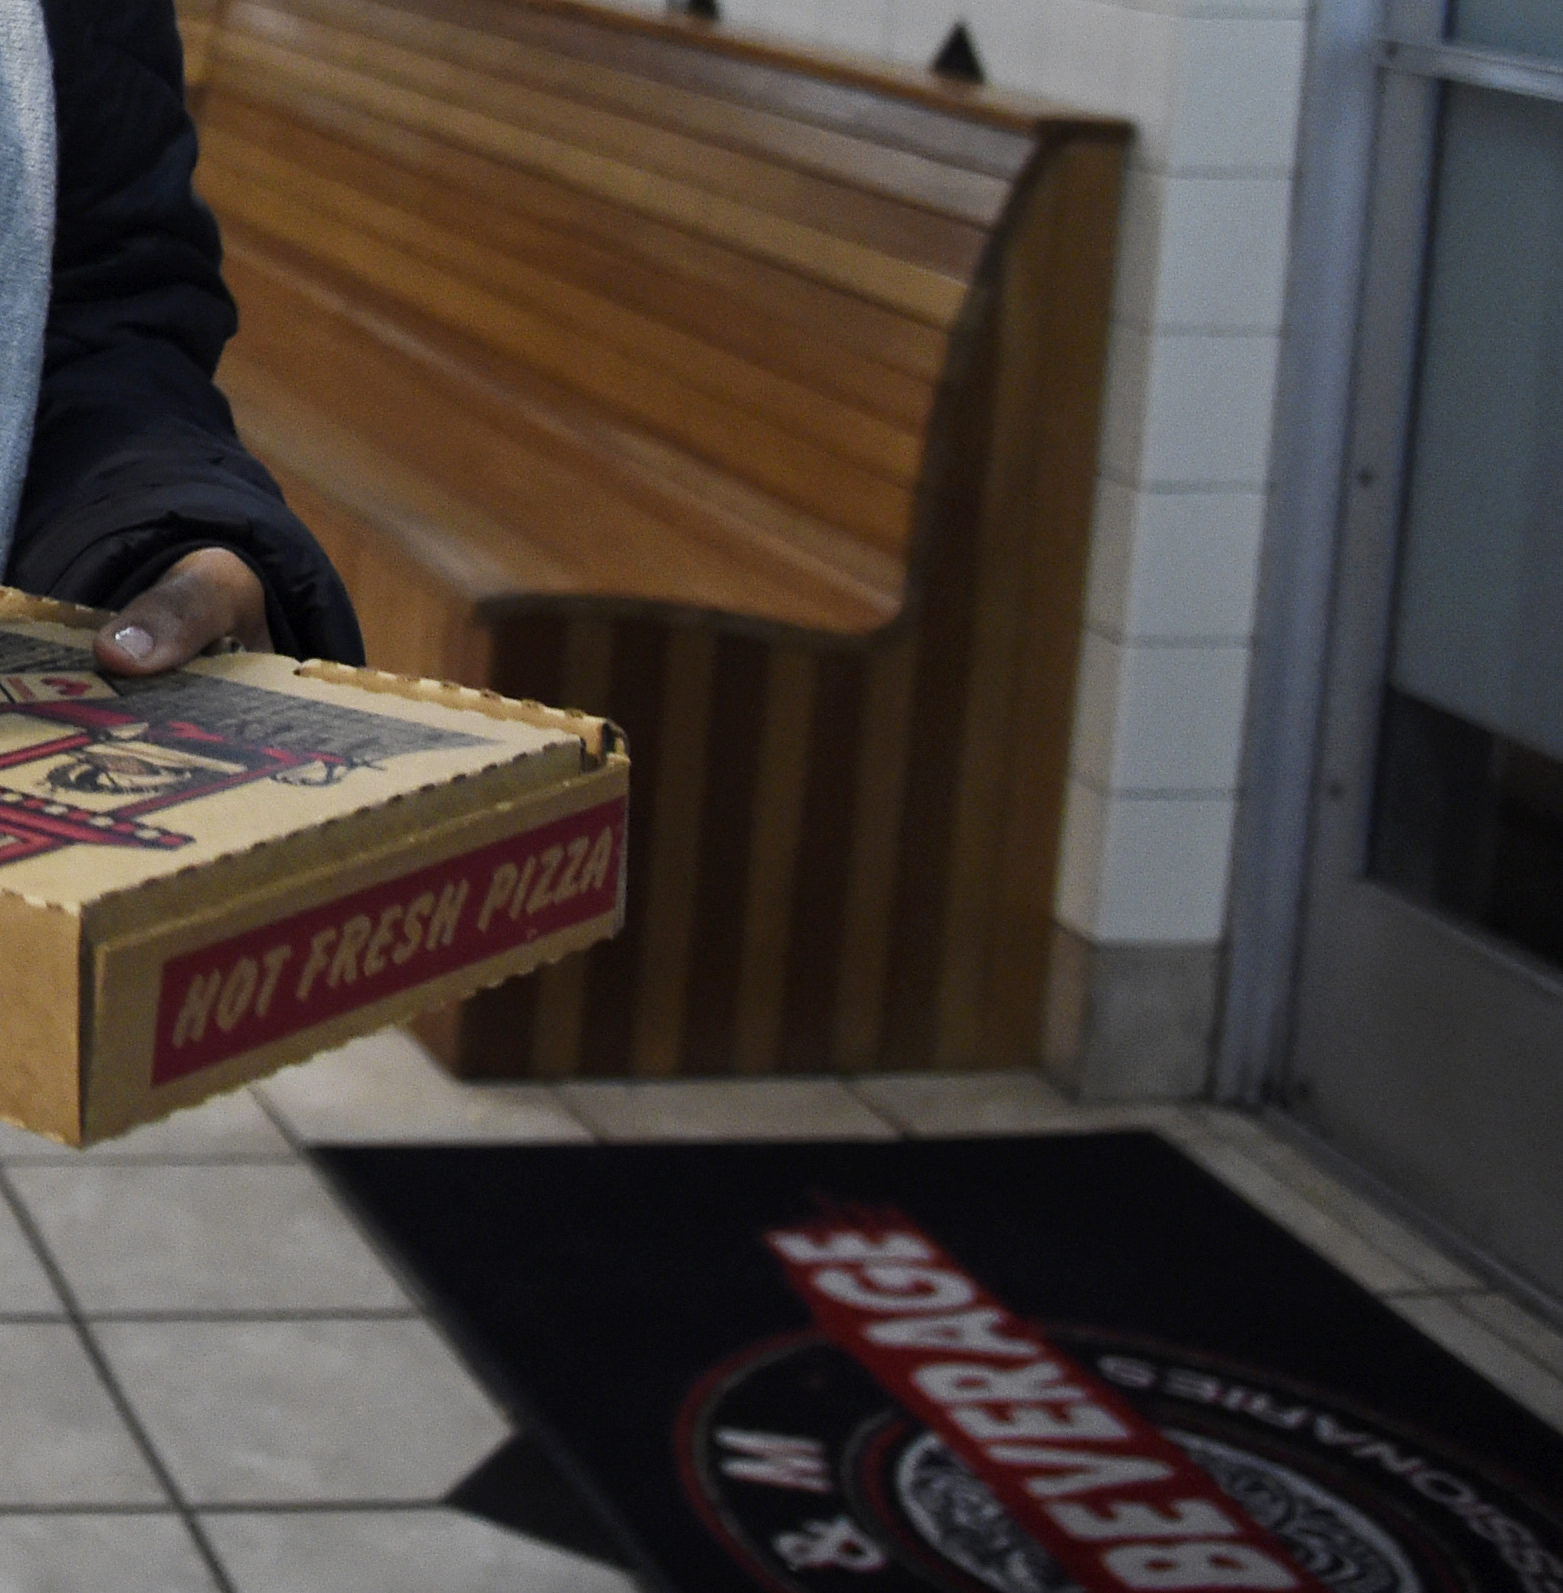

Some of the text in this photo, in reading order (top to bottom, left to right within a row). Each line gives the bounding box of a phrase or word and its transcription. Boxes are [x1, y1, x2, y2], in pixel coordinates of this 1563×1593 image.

[173, 824, 613, 1049] HOT FRESH PIZZA
[771, 1230, 1300, 1589] BEVERAGE
